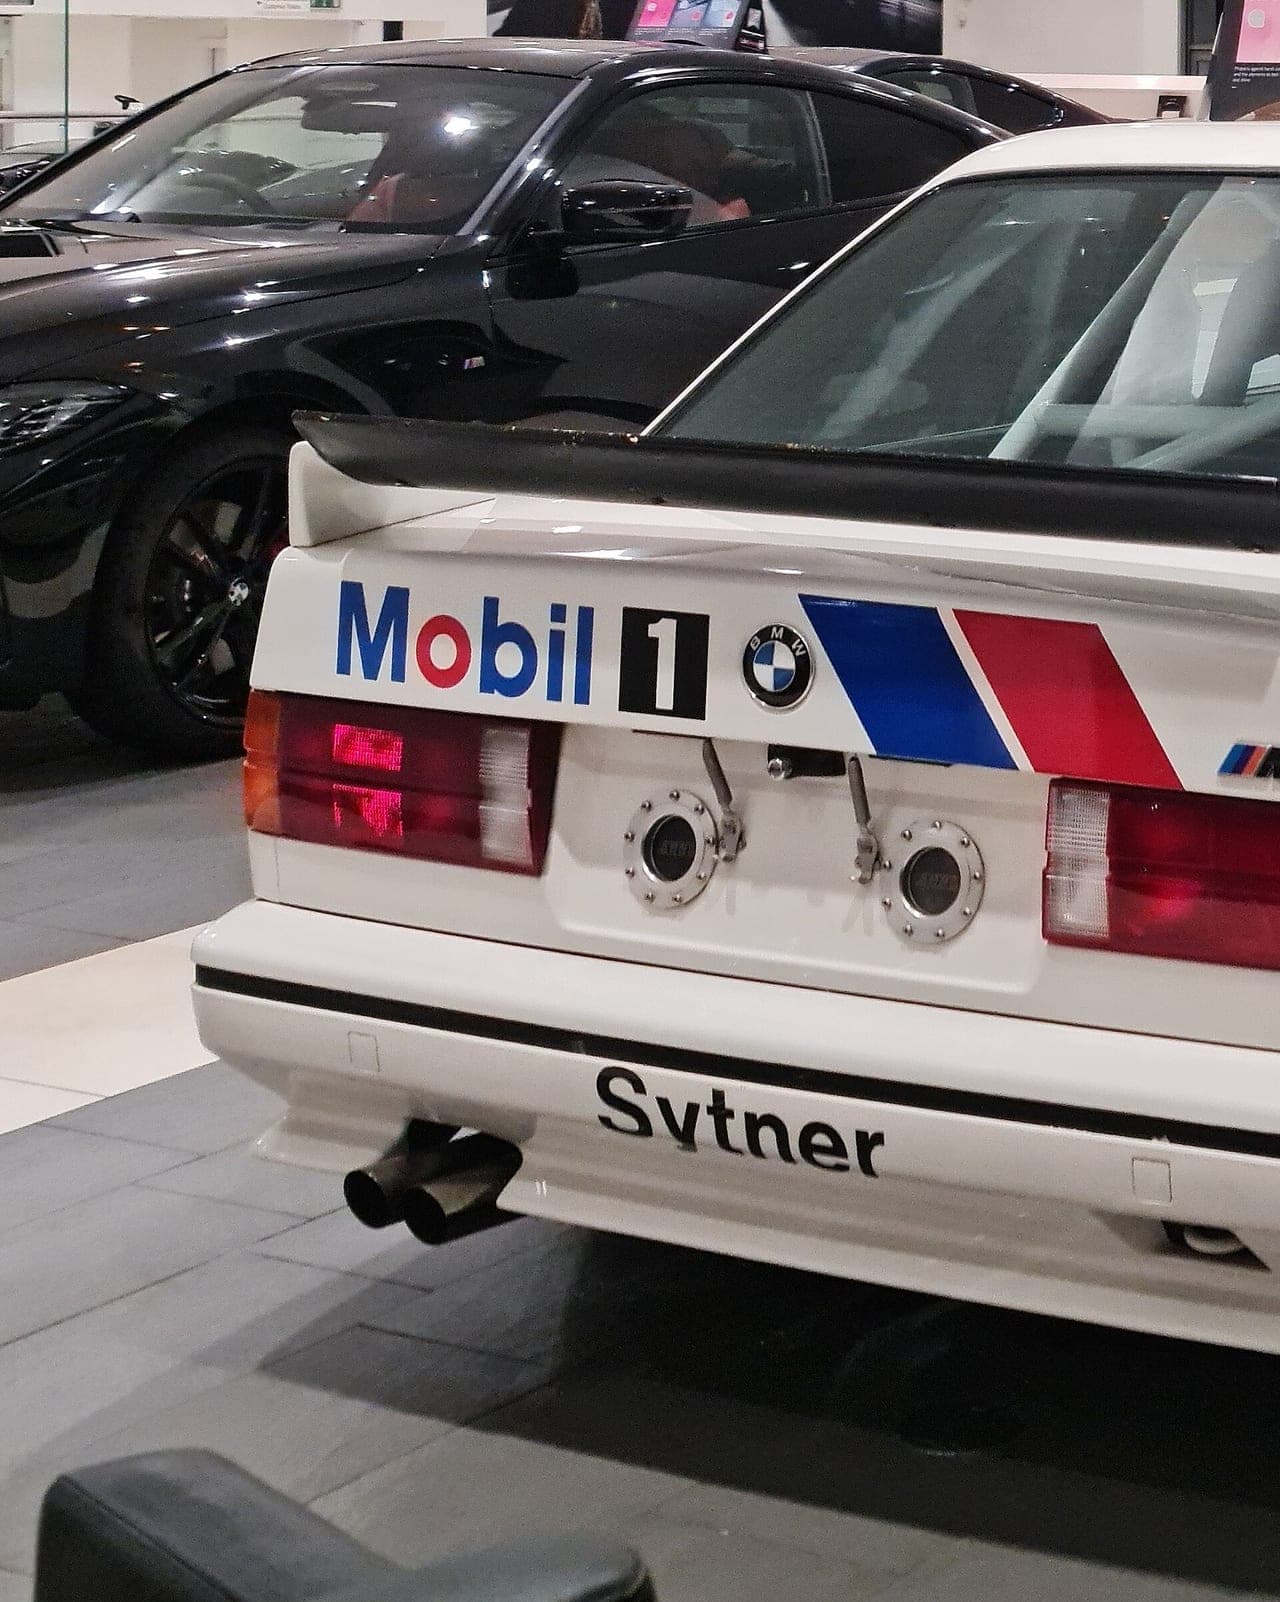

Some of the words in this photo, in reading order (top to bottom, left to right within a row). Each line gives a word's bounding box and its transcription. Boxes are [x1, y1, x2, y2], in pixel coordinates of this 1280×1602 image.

[336, 580, 596, 706] Mobil
[647, 616, 678, 712] 1
[749, 626, 807, 657] BMW
[595, 1066, 886, 1178] Sytner
